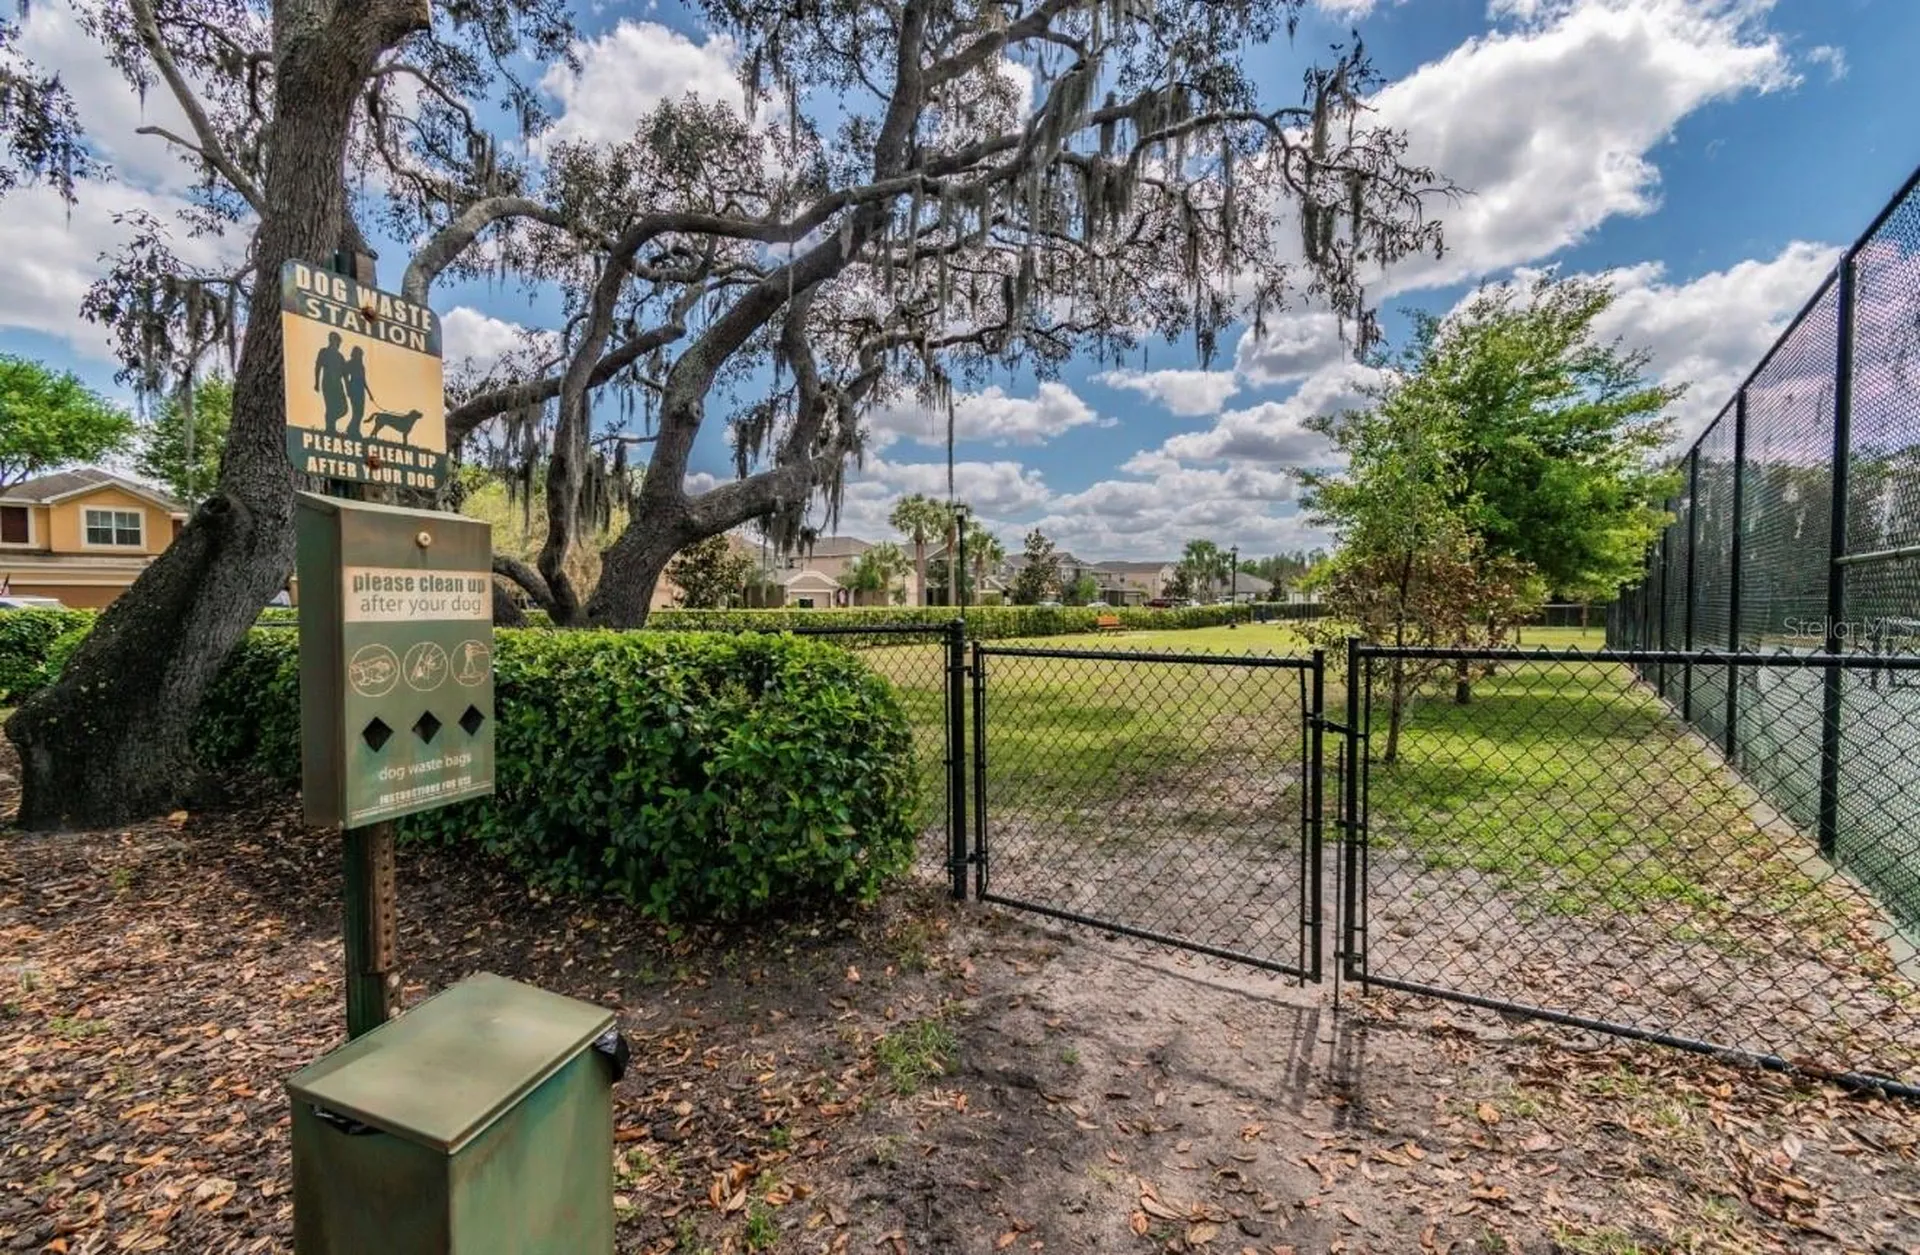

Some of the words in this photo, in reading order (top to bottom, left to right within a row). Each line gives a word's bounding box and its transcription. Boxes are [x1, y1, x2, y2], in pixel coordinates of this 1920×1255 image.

[296, 264, 347, 303] DOG
[356, 285, 431, 332] WASTE
[306, 299, 426, 350] STATION
[303, 432, 363, 458] PLEASE
[368, 445, 413, 467] CLEAN
[418, 453, 436, 469] UP
[307, 456, 356, 478] AFTER
[362, 464, 402, 484] YOUR
[407, 472, 436, 489] DOG
[353, 573, 414, 593] please
[420, 574, 463, 593] clean
[468, 579, 486, 594] up
[360, 594, 403, 612] after
[406, 599, 446, 616] your
[451, 596, 481, 615] dog
[379, 766, 405, 780] dog
[408, 759, 443, 774] waste
[444, 753, 471, 768] bags
